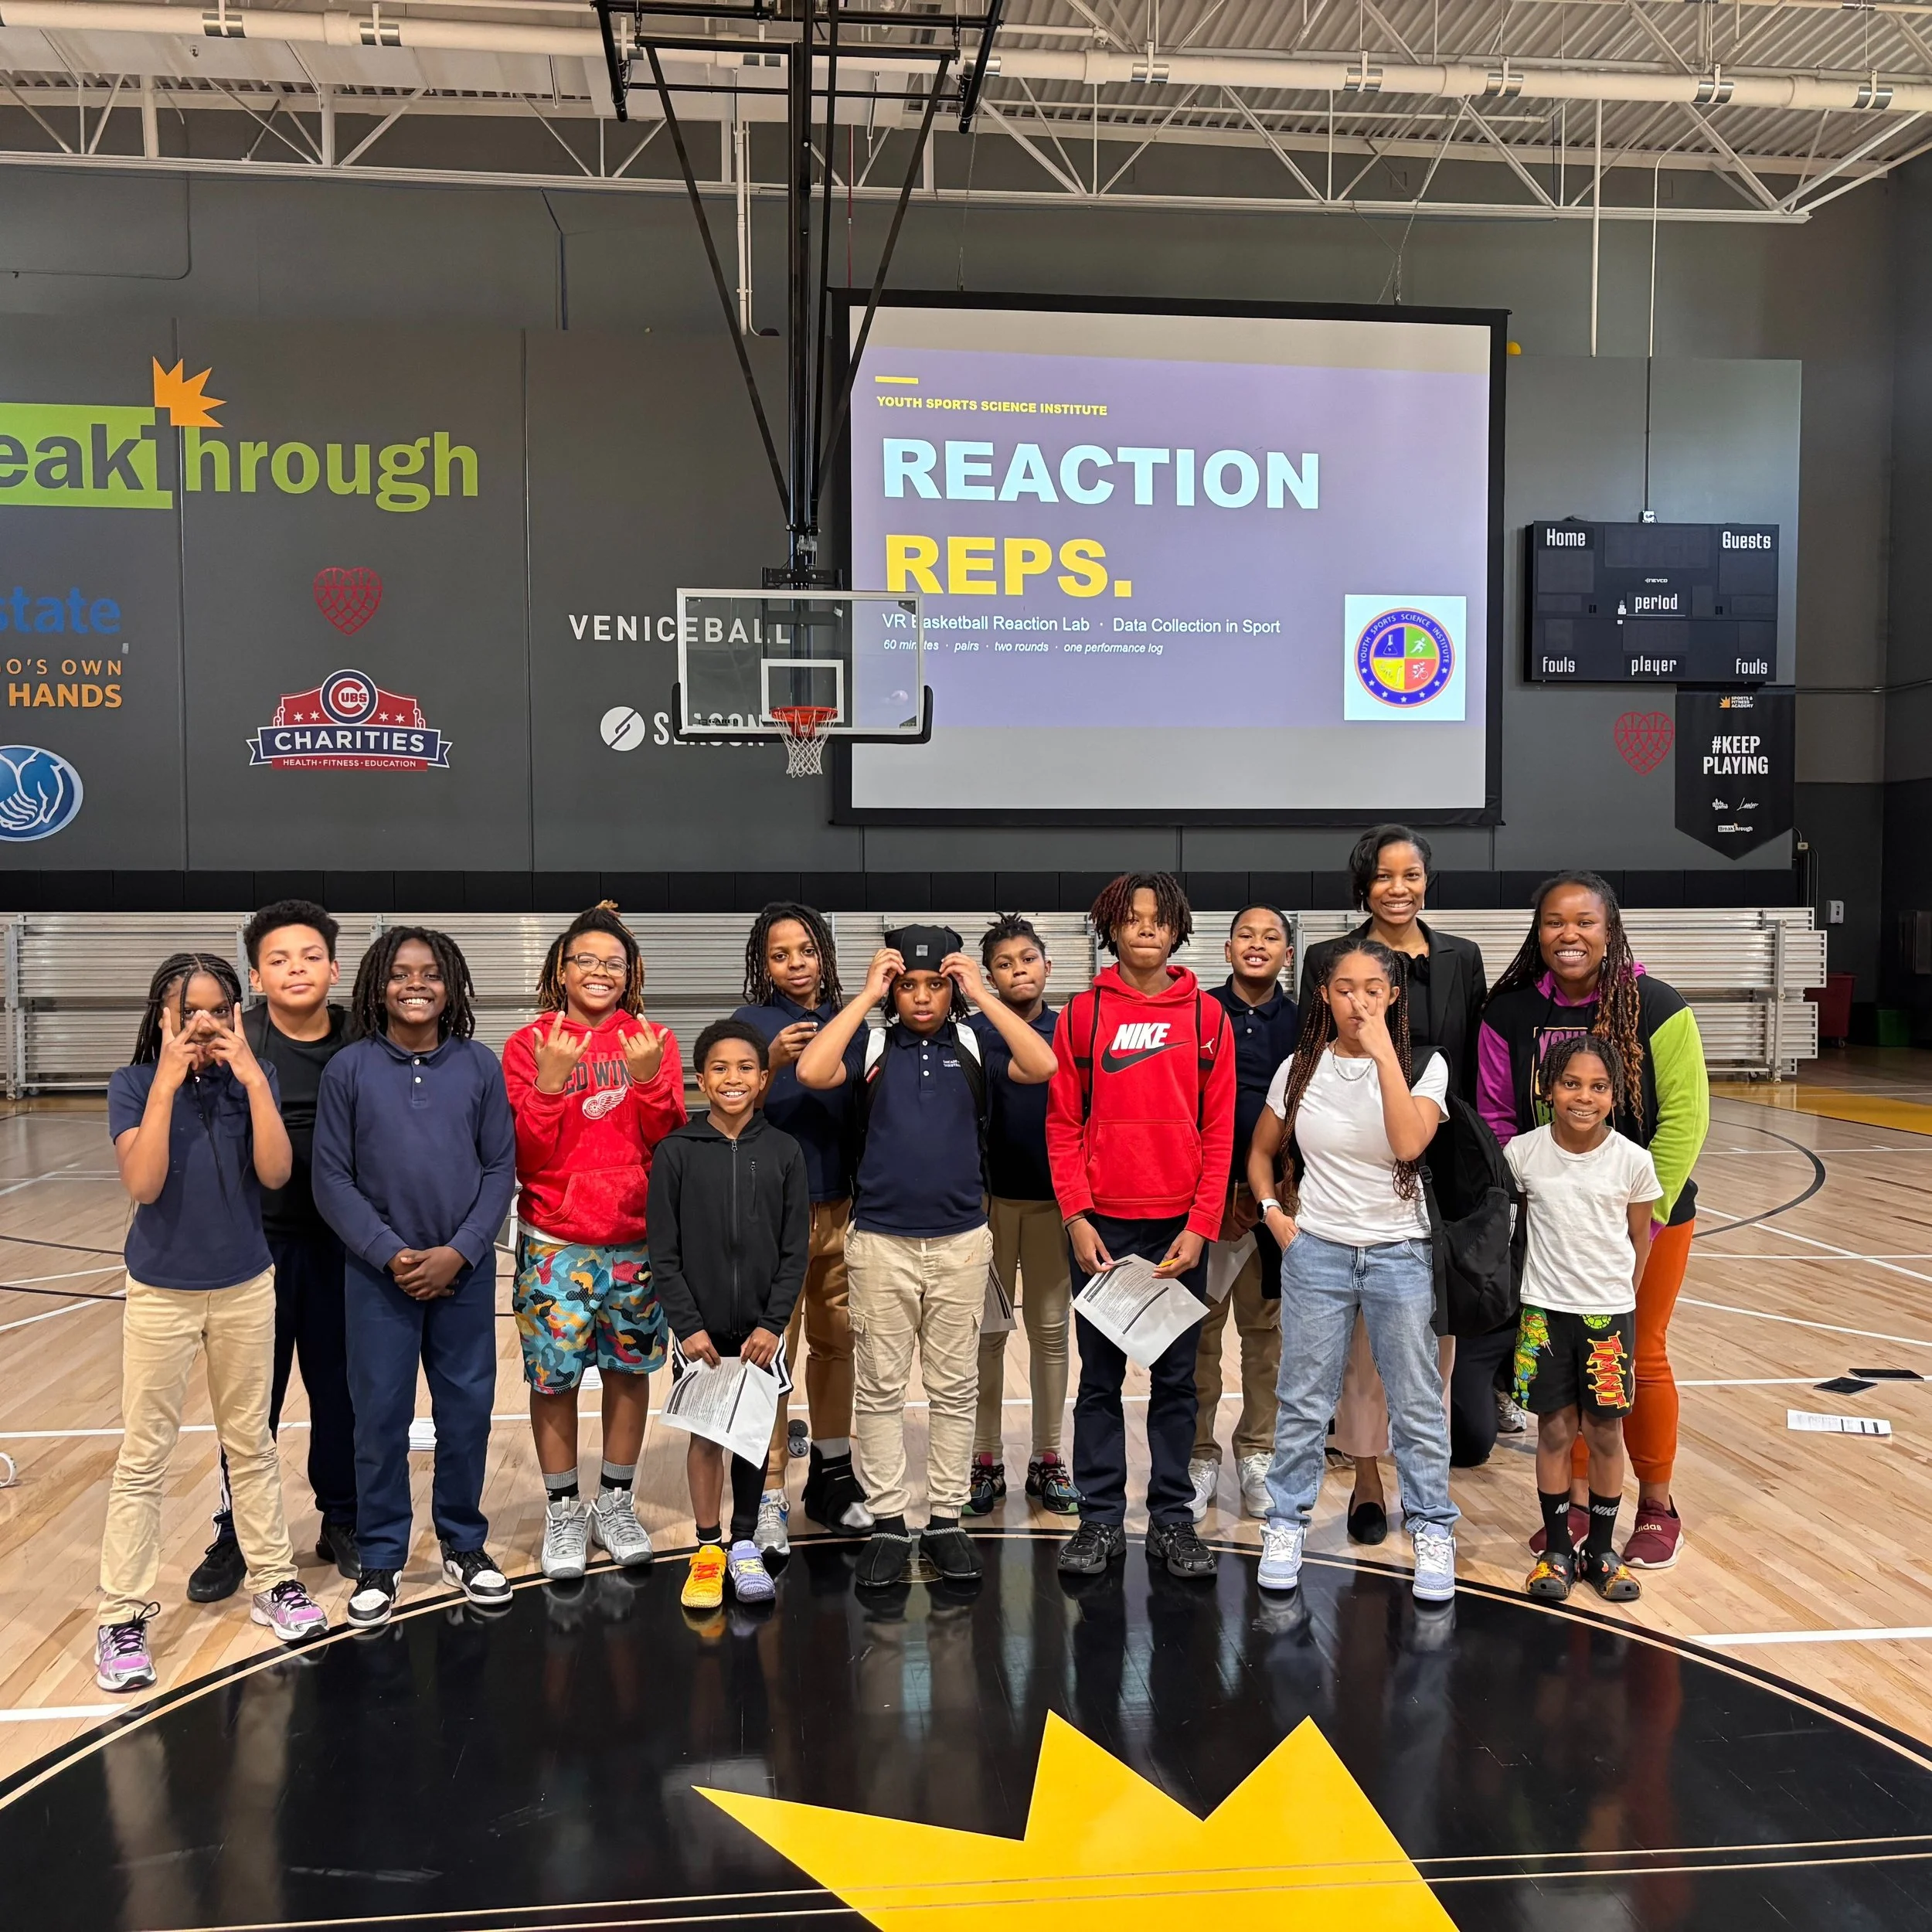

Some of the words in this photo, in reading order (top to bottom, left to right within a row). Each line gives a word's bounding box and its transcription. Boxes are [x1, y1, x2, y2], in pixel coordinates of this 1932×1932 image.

[877, 396, 922, 408] YOUTH
[926, 398, 978, 411] SPORTS
[981, 401, 1037, 413] SCIENCE
[1040, 403, 1107, 416] INSTITUTE
[883, 437, 1319, 509] REACTION
[1546, 529, 1586, 547] Home
[1722, 531, 1771, 549] Guests
[886, 534, 1132, 597] REPS.
[1634, 593, 1678, 613] period
[568, 614, 791, 645] VENICEBALL
[882, 614, 906, 628] VR
[993, 616, 1058, 631] Reaction
[1063, 617, 1090, 631] Lab
[1113, 617, 1147, 632] Data
[1151, 618, 1221, 633] Collection
[1226, 619, 1238, 632] in
[1242, 619, 1281, 636] Sport
[883, 639, 897, 650] 60
[899, 639, 939, 650] mintes
[954, 641, 979, 653] pairs
[995, 641, 1012, 651] two
[1015, 641, 1049, 652] rounds
[1063, 643, 1083, 652] one
[1084, 642, 1145, 655] performance
[1148, 643, 1163, 655] log
[1360, 636, 1372, 663] YOUTH
[1370, 614, 1396, 635] SPORTS
[1400, 613, 1431, 628] SCIENCE
[1432, 627, 1450, 663] INSTITUTE
[0, 658, 48, 675] O'S
[61, 659, 121, 675] OWN
[1631, 655, 1677, 675] player
[9, 683, 122, 708] HANDS
[274, 730, 424, 753] CHARITIES
[1712, 736, 1760, 754] #KEEP
[1702, 756, 1769, 775] PLAYING
[1111, 1022, 1171, 1051] NIKE
[565, 1062, 587, 1096] ED
[1635, 1523, 1662, 1533] didas
